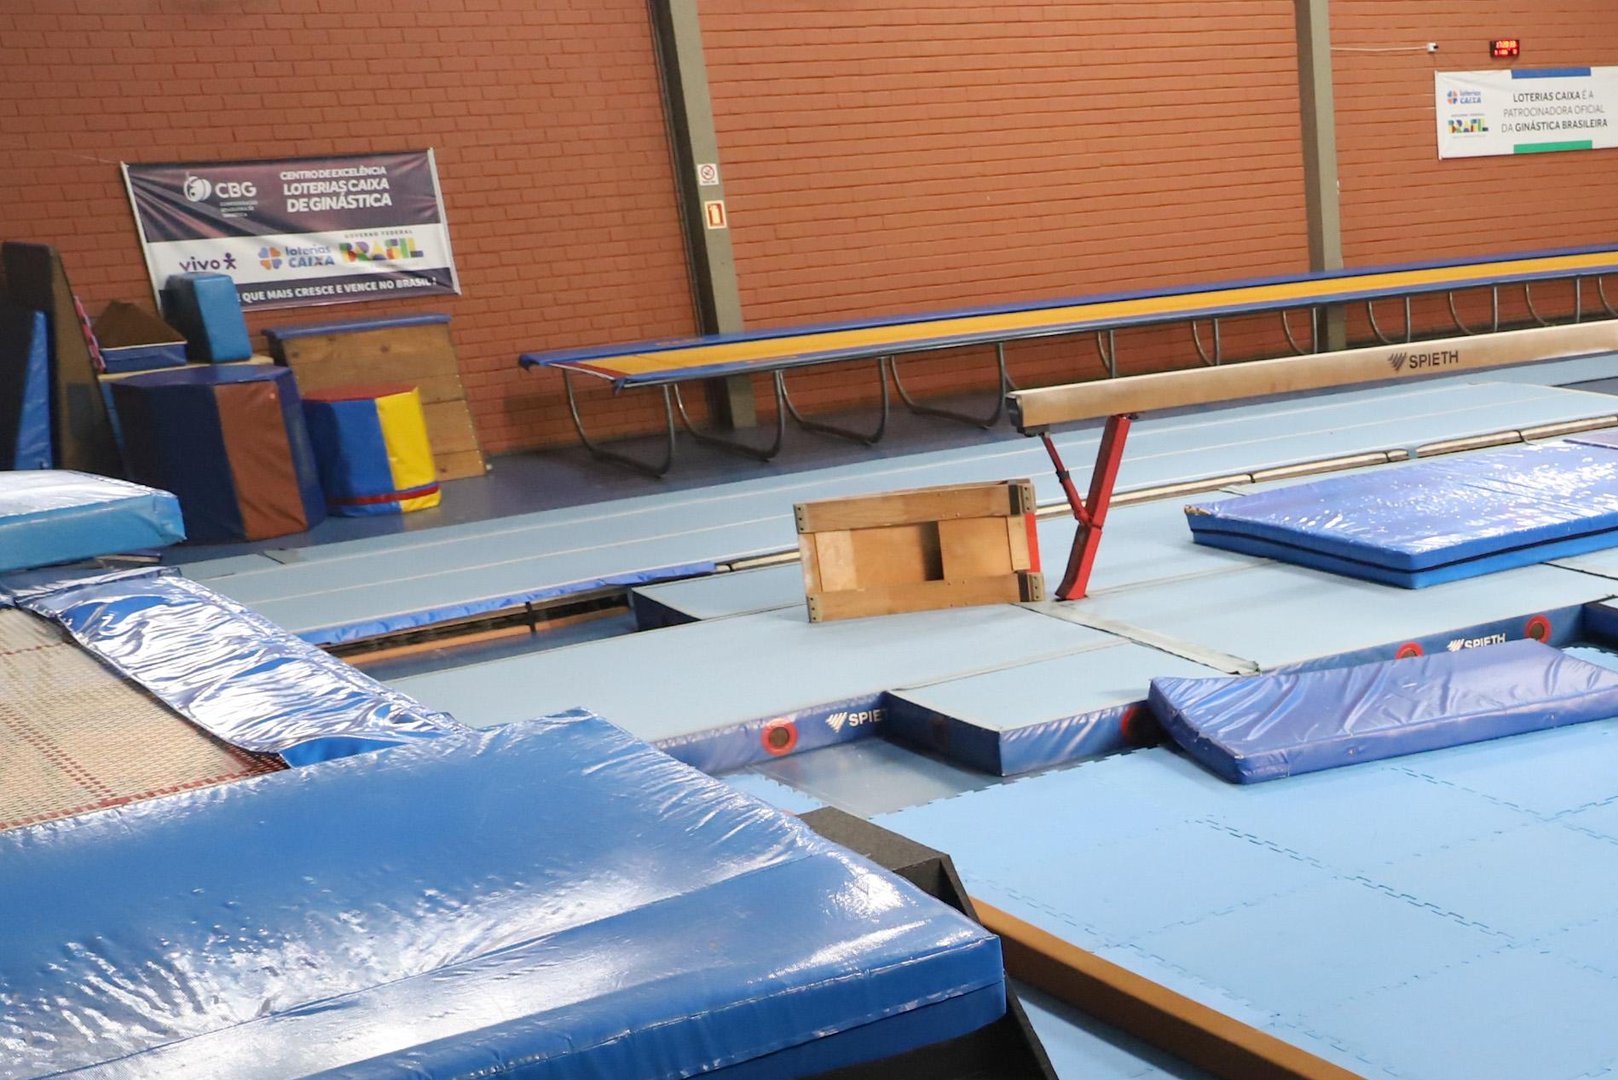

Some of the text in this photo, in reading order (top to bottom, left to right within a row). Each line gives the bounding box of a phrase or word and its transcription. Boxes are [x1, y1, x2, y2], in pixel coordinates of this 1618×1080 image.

[1513, 92, 1554, 103] LOTERIAS
[1555, 91, 1581, 101] CAIXA
[1588, 90, 1594, 99] A
[1503, 104, 1605, 118] PATROCINADORA OFICIAL
[1501, 118, 1608, 133] DA GINÁSTICA BRASILEIRA
[280, 165, 387, 180] CENTRO DE EXCELÊNCIA
[215, 181, 257, 198] CBG
[283, 178, 389, 195] LOTERIAS CAIXA
[287, 191, 392, 212] DE GINÁSTICA
[179, 256, 221, 271] vivo
[289, 255, 335, 268] CAIXA
[242, 290, 266, 303] QUE
[267, 288, 293, 300] MAIS
[295, 285, 335, 298] CRESCE
[336, 284, 343, 293] E
[344, 281, 377, 292] VENCE
[379, 279, 395, 289] NO
[396, 277, 431, 289] BRASIL
[1409, 350, 1459, 369] SPIETH
[1464, 633, 1506, 649] SPIETH
[848, 709, 884, 727] SPIE
